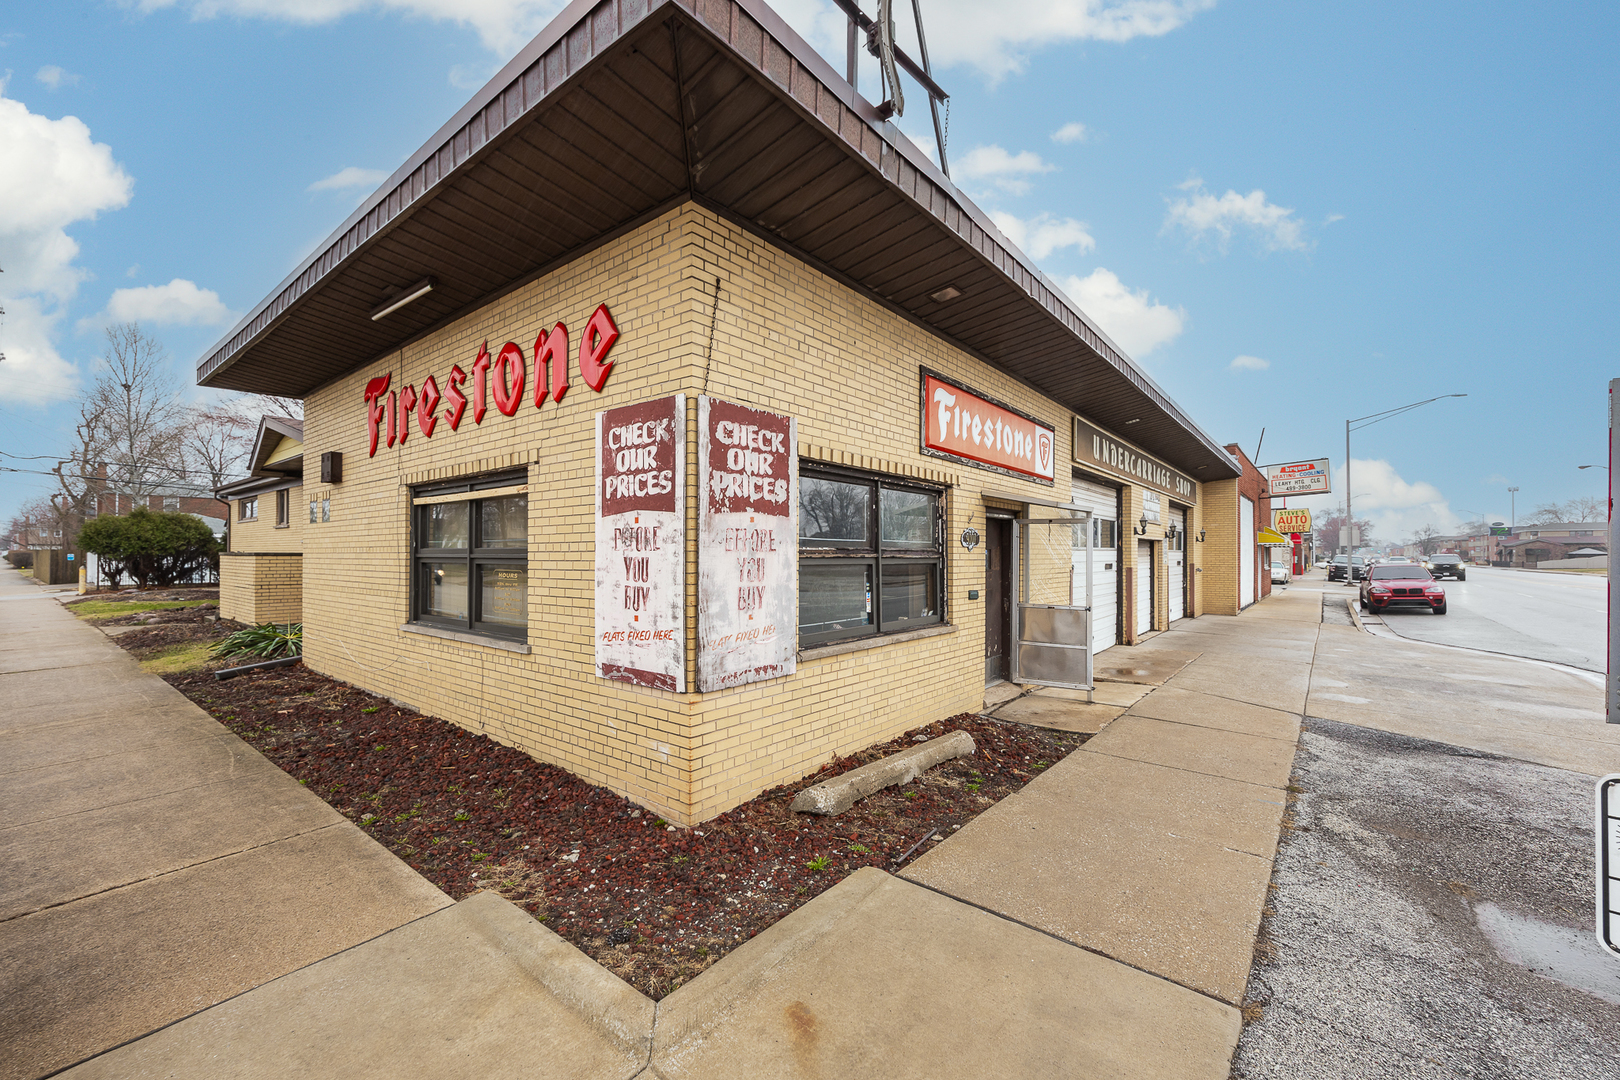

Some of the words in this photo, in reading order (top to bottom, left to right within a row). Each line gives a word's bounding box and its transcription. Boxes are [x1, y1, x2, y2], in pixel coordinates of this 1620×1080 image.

[364, 302, 619, 458] Firestone
[608, 418, 669, 450] CHECK
[715, 421, 786, 453] CHECK
[934, 387, 1033, 461] Firestone
[616, 445, 658, 472] OUR
[727, 447, 774, 475] OUR
[1093, 434, 1171, 489] UNDERCARRIAGE
[1285, 464, 1310, 472] bryant
[605, 470, 673, 499] PRICES
[711, 470, 787, 503] PRICES
[1176, 476, 1191, 497] SHOP
[1278, 515, 1308, 525] AUTO
[725, 527, 777, 552] BEFORE
[623, 557, 649, 583] YOU
[737, 557, 765, 582] YOU
[624, 585, 651, 612] BUY
[738, 585, 766, 611] BUY
[602, 631, 626, 642] FLATS
[627, 629, 652, 641] FIXED
[653, 629, 675, 641] HERE
[735, 627, 760, 642] FIXED
